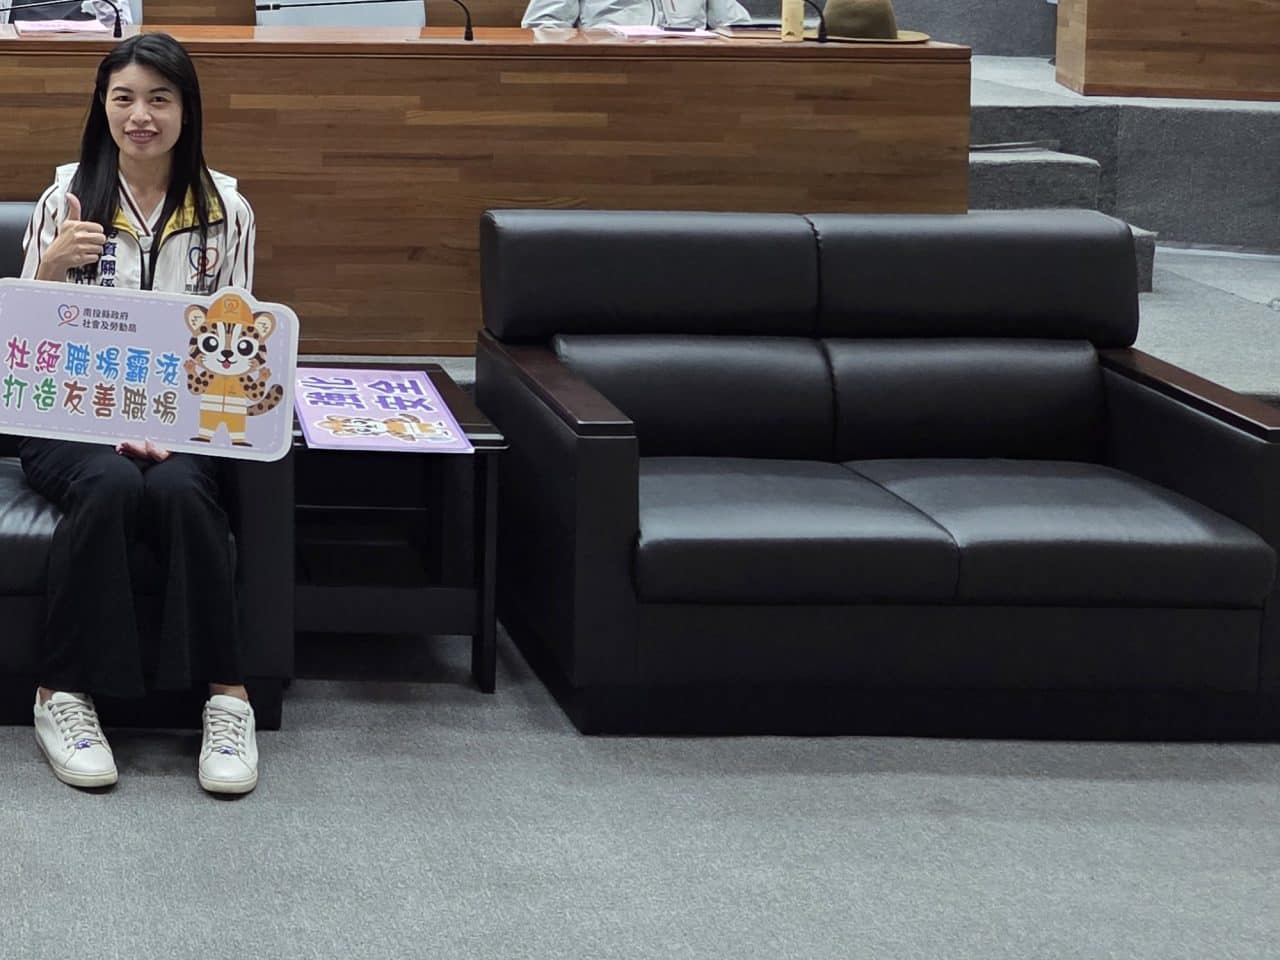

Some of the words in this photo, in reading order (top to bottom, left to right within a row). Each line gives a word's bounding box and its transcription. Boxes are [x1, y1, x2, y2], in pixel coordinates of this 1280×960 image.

[5, 336, 181, 387] 杜絕職場霸凌
[2, 373, 178, 426] 打造友善職場
[368, 379, 435, 412] 安全
